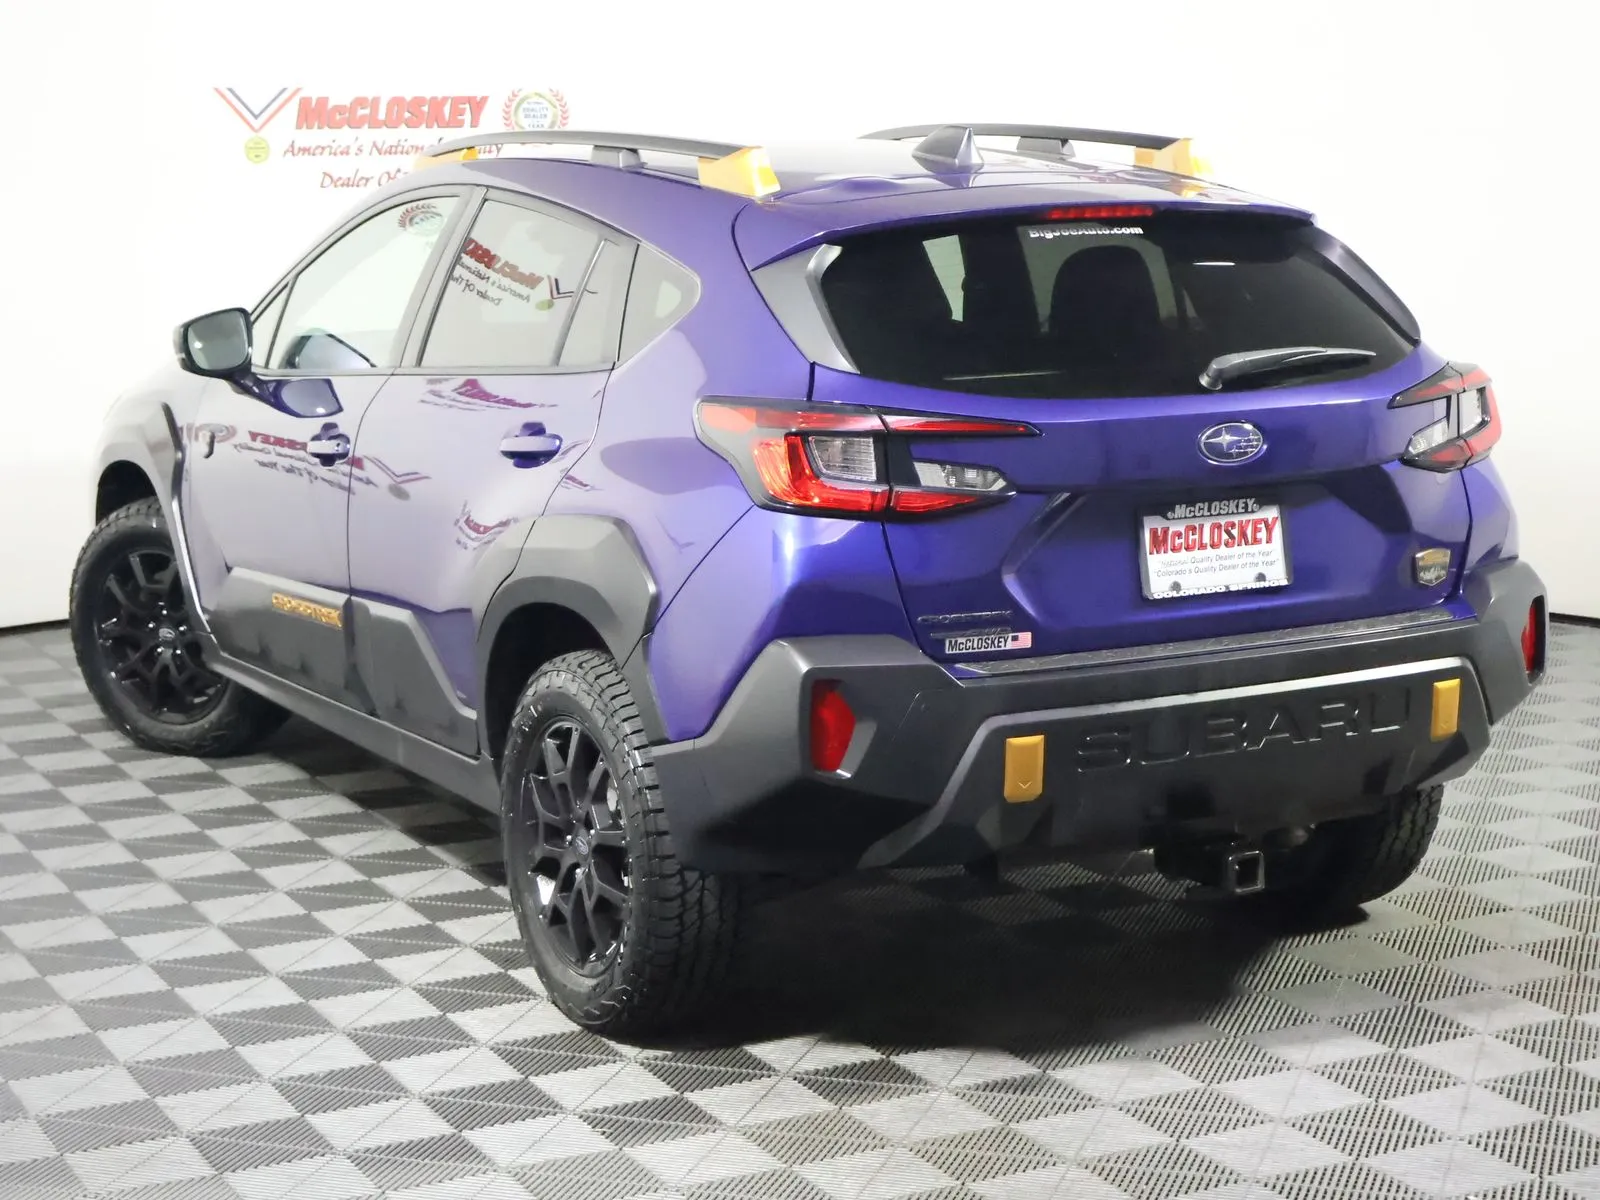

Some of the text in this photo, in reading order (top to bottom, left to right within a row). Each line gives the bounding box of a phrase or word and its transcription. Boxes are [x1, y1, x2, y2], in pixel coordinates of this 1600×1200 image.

[295, 96, 489, 130] McCLOSKEY
[283, 136, 364, 158] America's
[320, 168, 374, 189] Dealer
[1174, 498, 1256, 519] McCLOSKEY
[1149, 516, 1278, 555] McCLOSKEY
[1190, 555, 1213, 565] Quality
[1215, 552, 1236, 562] Dealer
[1193, 565, 1217, 575] Quality
[1219, 563, 1240, 571] Dealer
[947, 634, 1010, 653] McCLOSKEY
[1077, 686, 1411, 774] SUBARU
